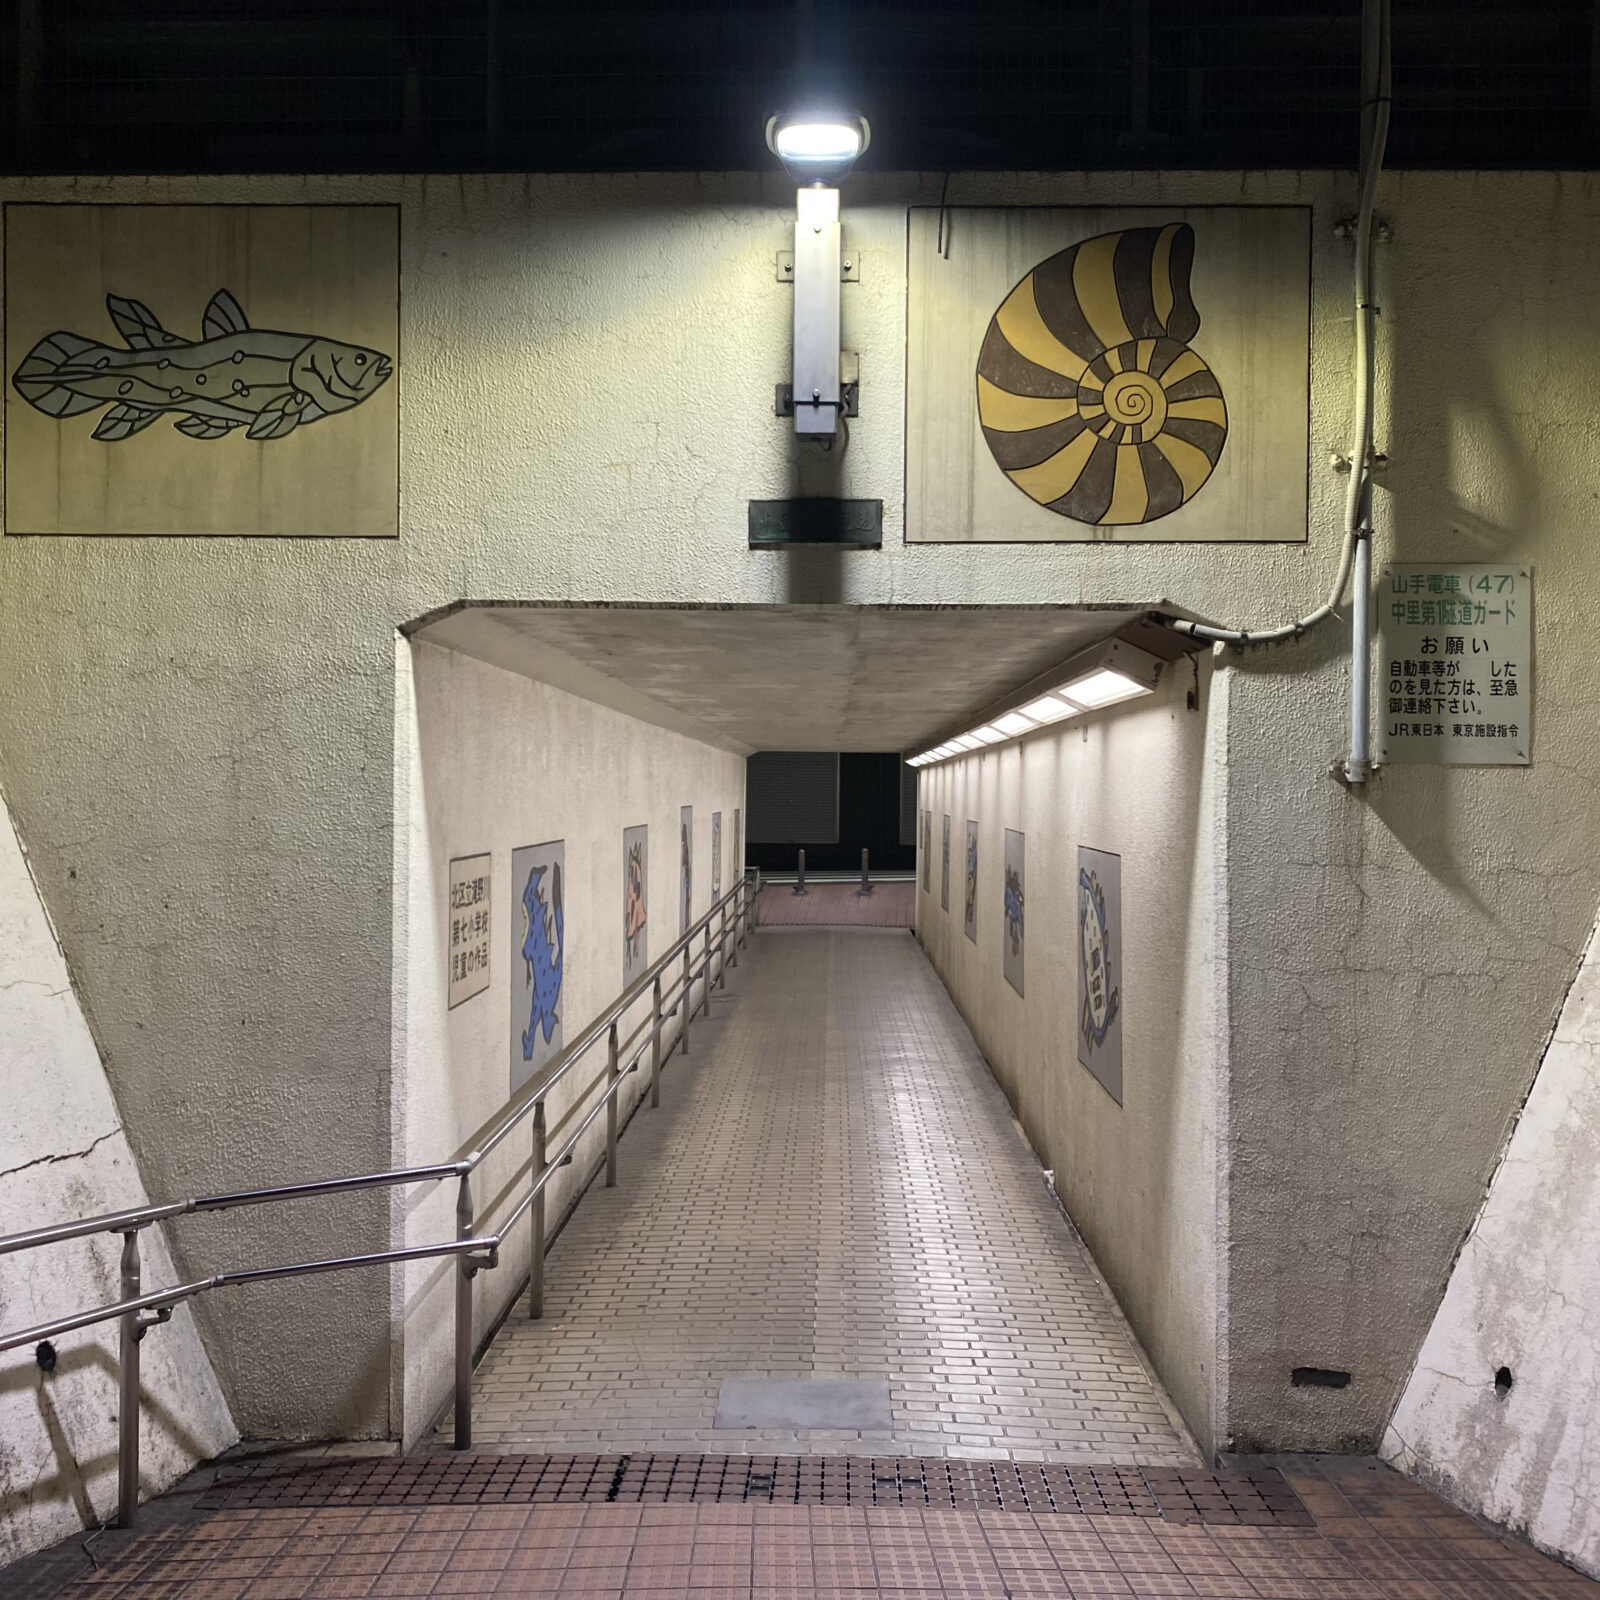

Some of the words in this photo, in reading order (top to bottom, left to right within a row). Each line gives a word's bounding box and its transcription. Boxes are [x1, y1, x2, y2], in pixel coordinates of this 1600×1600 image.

[1421, 636, 1489, 655] お願い
[1390, 660, 1460, 677] 自動車等が
[1491, 661, 1516, 677] した
[1389, 698, 1481, 715] 御連絡下さい。
[1388, 723, 1444, 737] JR東日本
[1452, 723, 1519, 738] 東京施設指令
[452, 911, 488, 947] 第七小学校
[451, 942, 488, 983] 児童の作品
